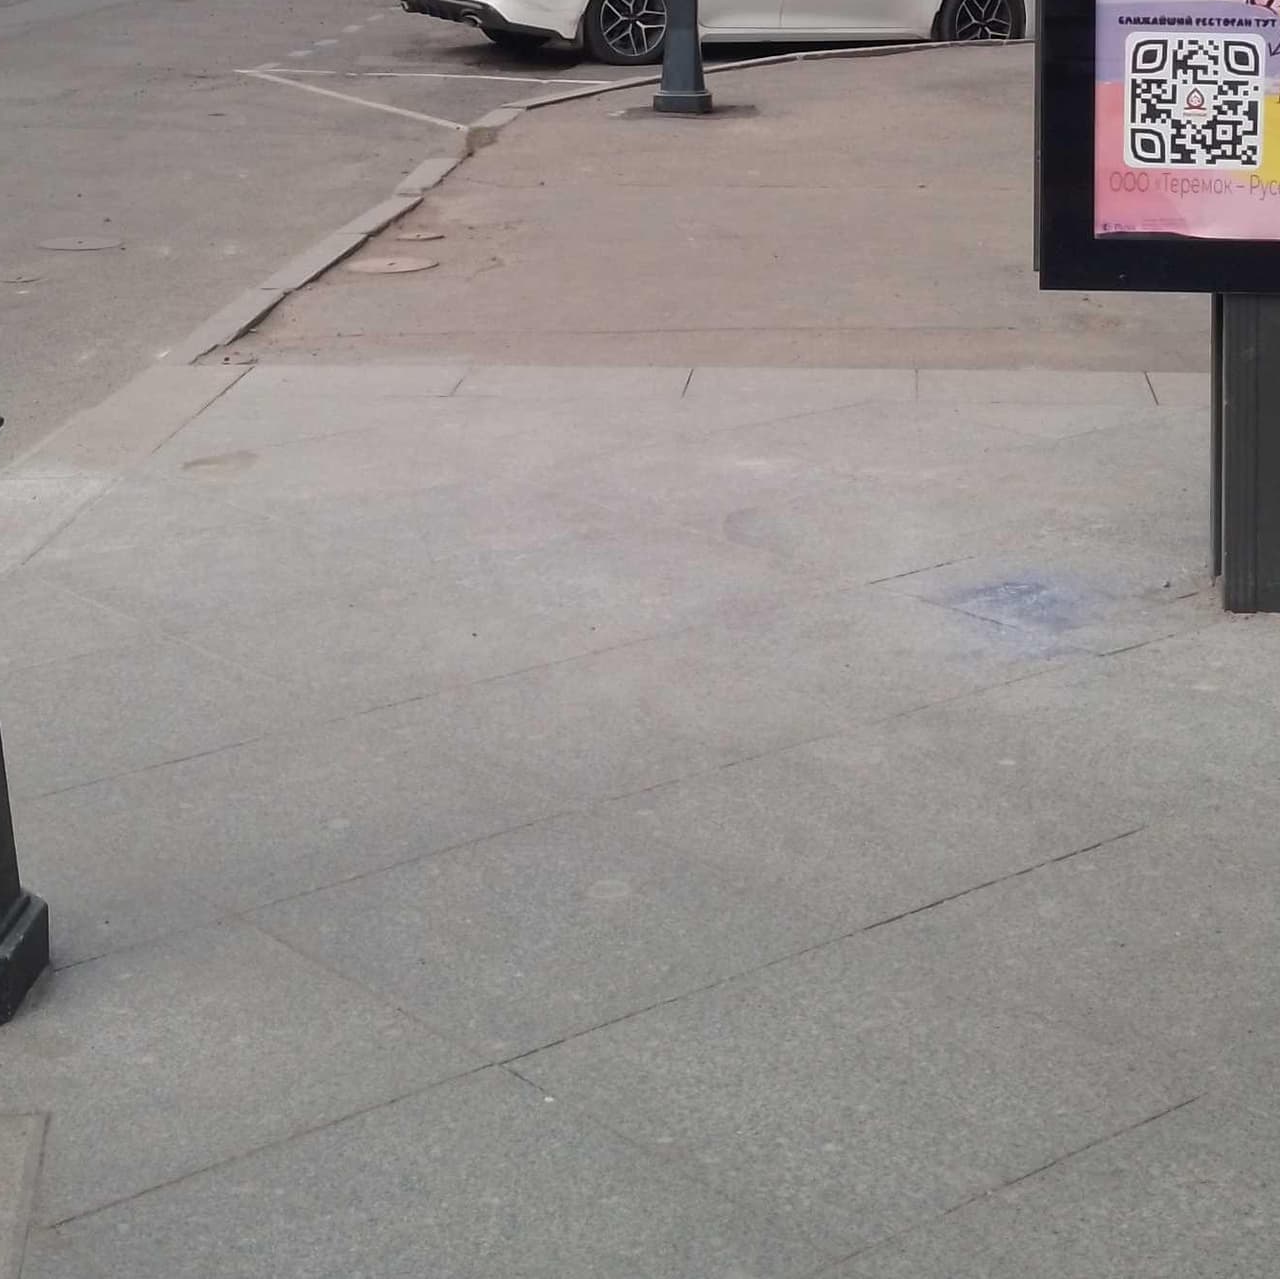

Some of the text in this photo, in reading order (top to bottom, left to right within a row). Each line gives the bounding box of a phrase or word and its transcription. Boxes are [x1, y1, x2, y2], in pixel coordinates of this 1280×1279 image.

[1118, 15, 1277, 28] БЛИЖАЙШИЙ РЕСТОРАН ТУТ
[1109, 173, 1150, 193] ООО
